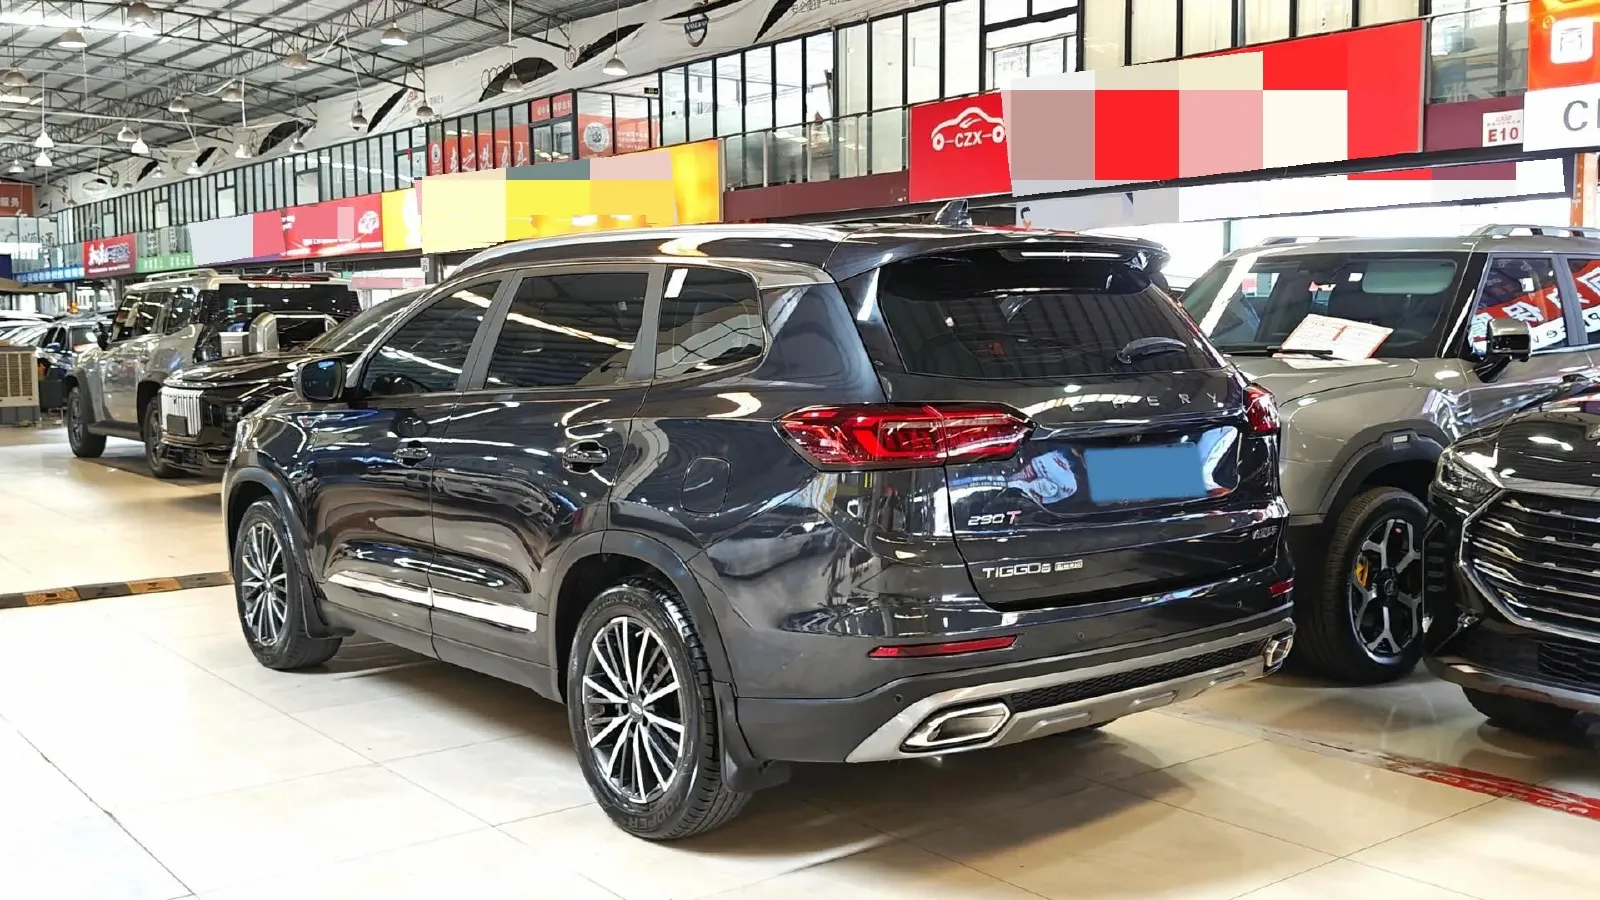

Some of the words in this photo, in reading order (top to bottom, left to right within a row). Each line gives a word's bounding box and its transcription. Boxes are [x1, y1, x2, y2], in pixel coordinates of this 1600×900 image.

[685, 20, 709, 32] VOLVO
[954, 130, 983, 148] CZX
[1488, 127, 1519, 143] E10
